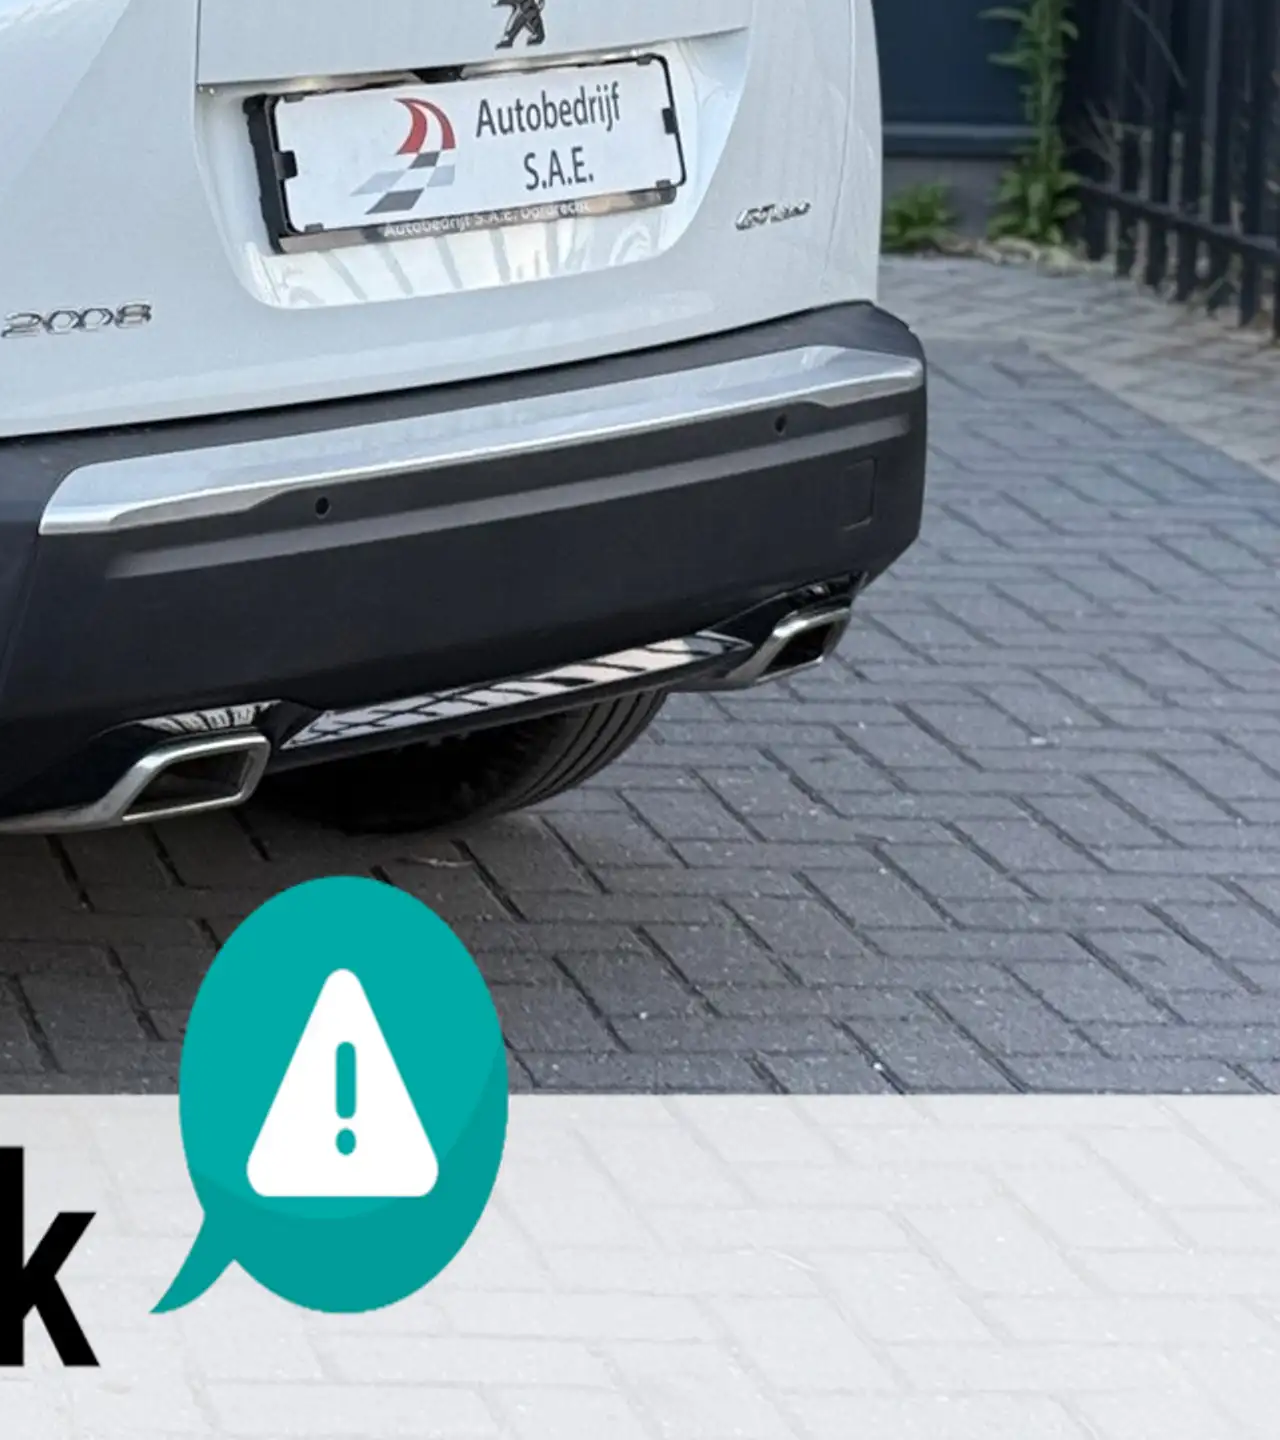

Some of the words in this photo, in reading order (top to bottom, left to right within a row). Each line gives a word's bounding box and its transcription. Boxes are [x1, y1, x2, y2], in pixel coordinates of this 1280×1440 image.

[475, 80, 621, 138] Autobedrijf
[522, 146, 595, 192] S.A.E.
[0, 301, 152, 338] 2008
